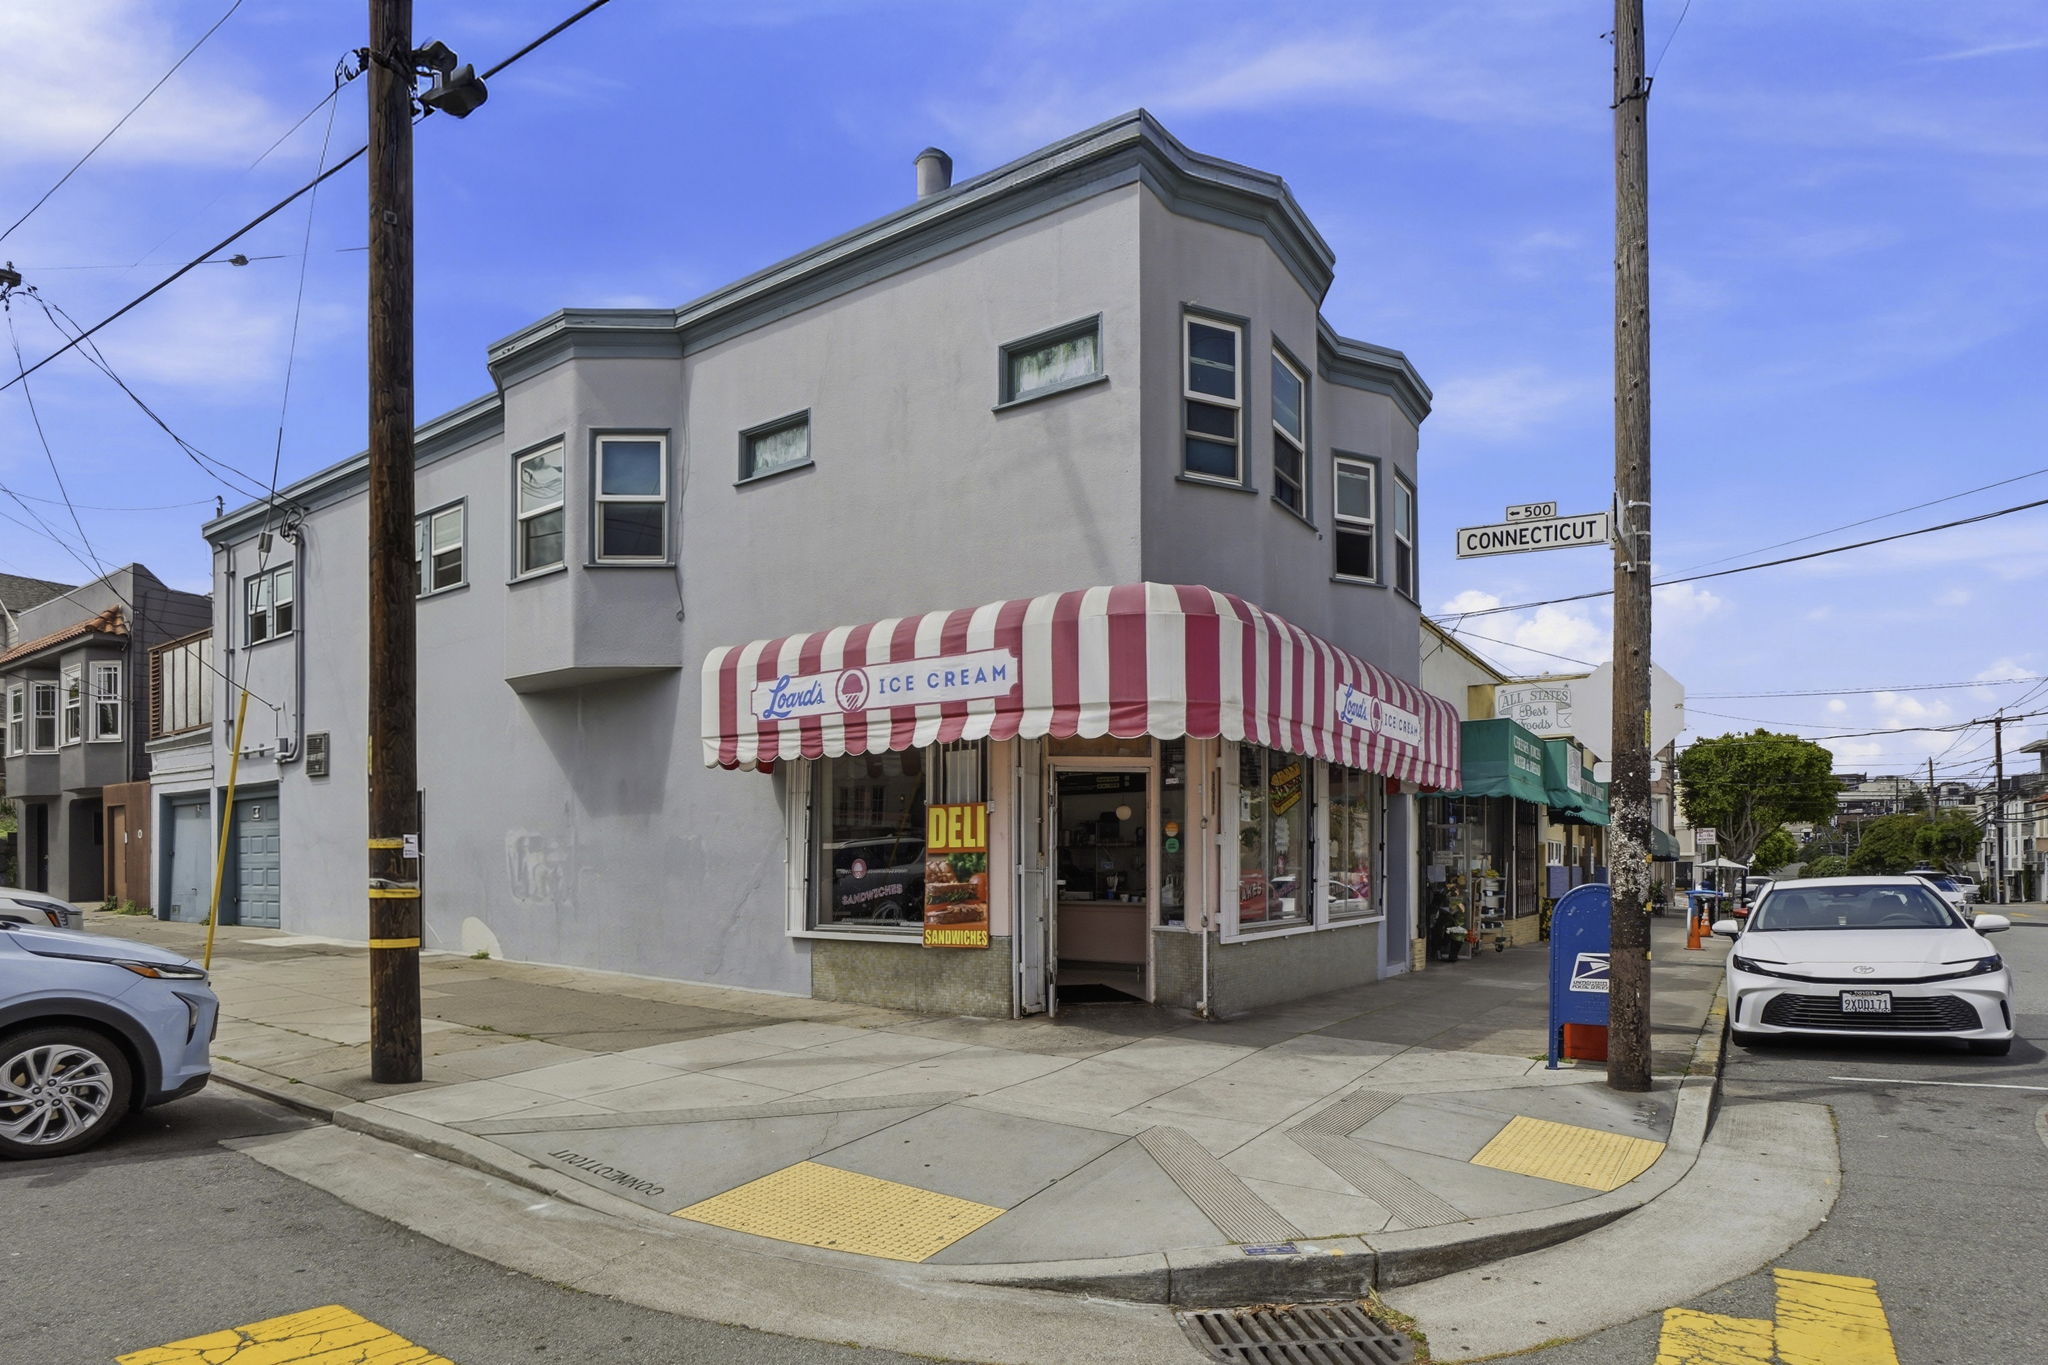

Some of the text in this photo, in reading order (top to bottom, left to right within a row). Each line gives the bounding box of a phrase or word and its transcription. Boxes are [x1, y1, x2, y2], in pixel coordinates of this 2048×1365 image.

[1524, 505, 1551, 517] 500
[1467, 520, 1596, 551] CONNECTICUT
[762, 664, 1007, 720] Loard's ICE CREAM
[1502, 690, 1568, 709] ALL STATES
[1340, 683, 1418, 736] Loard's ICE CREAM
[1520, 704, 1548, 717] Best
[1517, 718, 1553, 730] Foods
[928, 805, 985, 849] DELI
[842, 883, 904, 906] SANDWICHES
[1241, 883, 1263, 902] AKES
[925, 929, 988, 946] SANDWICHES
[547, 1149, 665, 1196] CONNECTICUT
